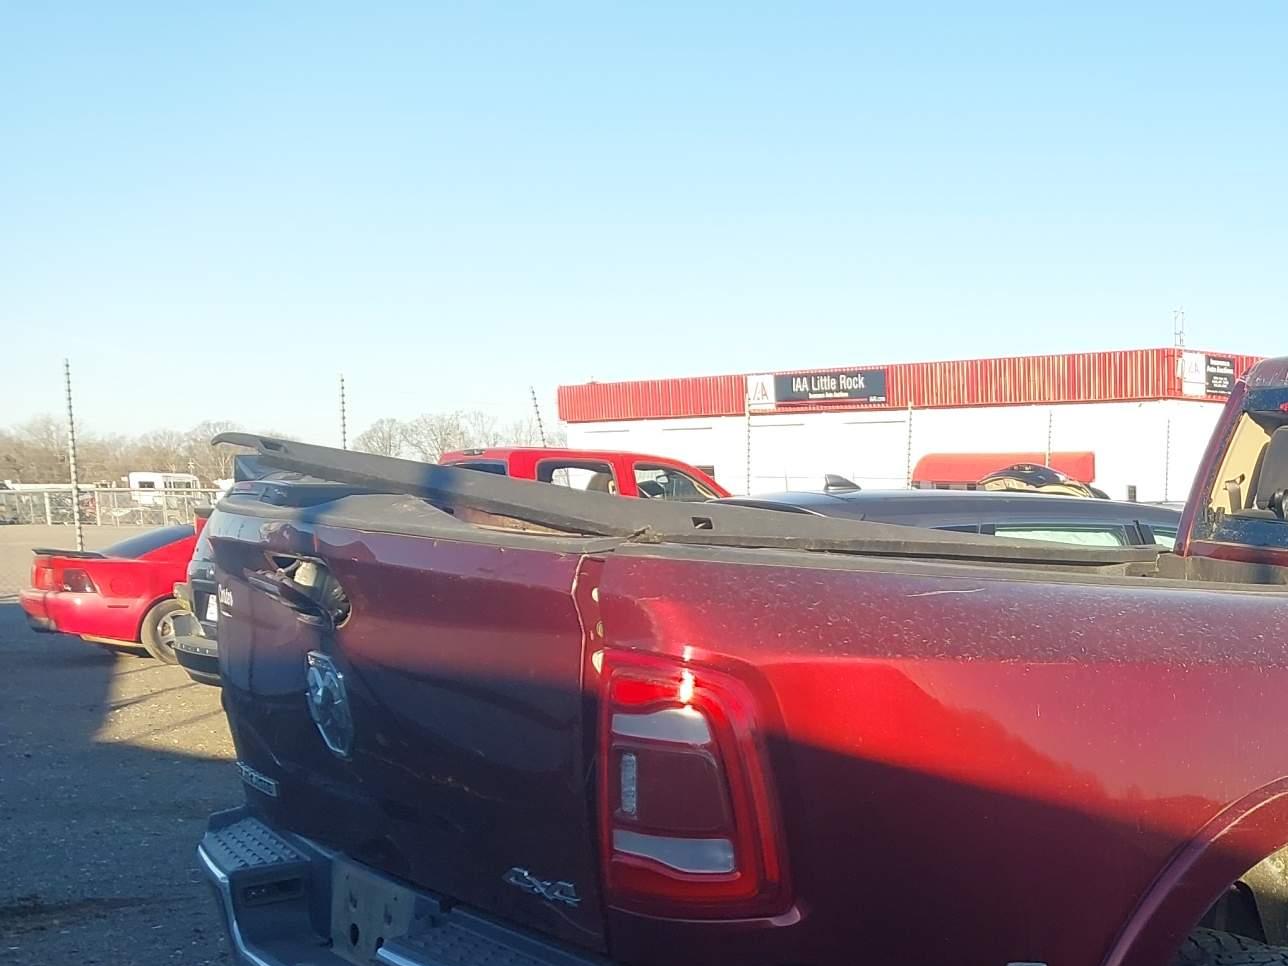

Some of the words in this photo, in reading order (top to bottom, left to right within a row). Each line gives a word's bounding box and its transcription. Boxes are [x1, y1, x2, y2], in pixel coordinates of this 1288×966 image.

[792, 377, 809, 392] IAA
[811, 375, 837, 391] Little
[839, 373, 865, 390] Rock
